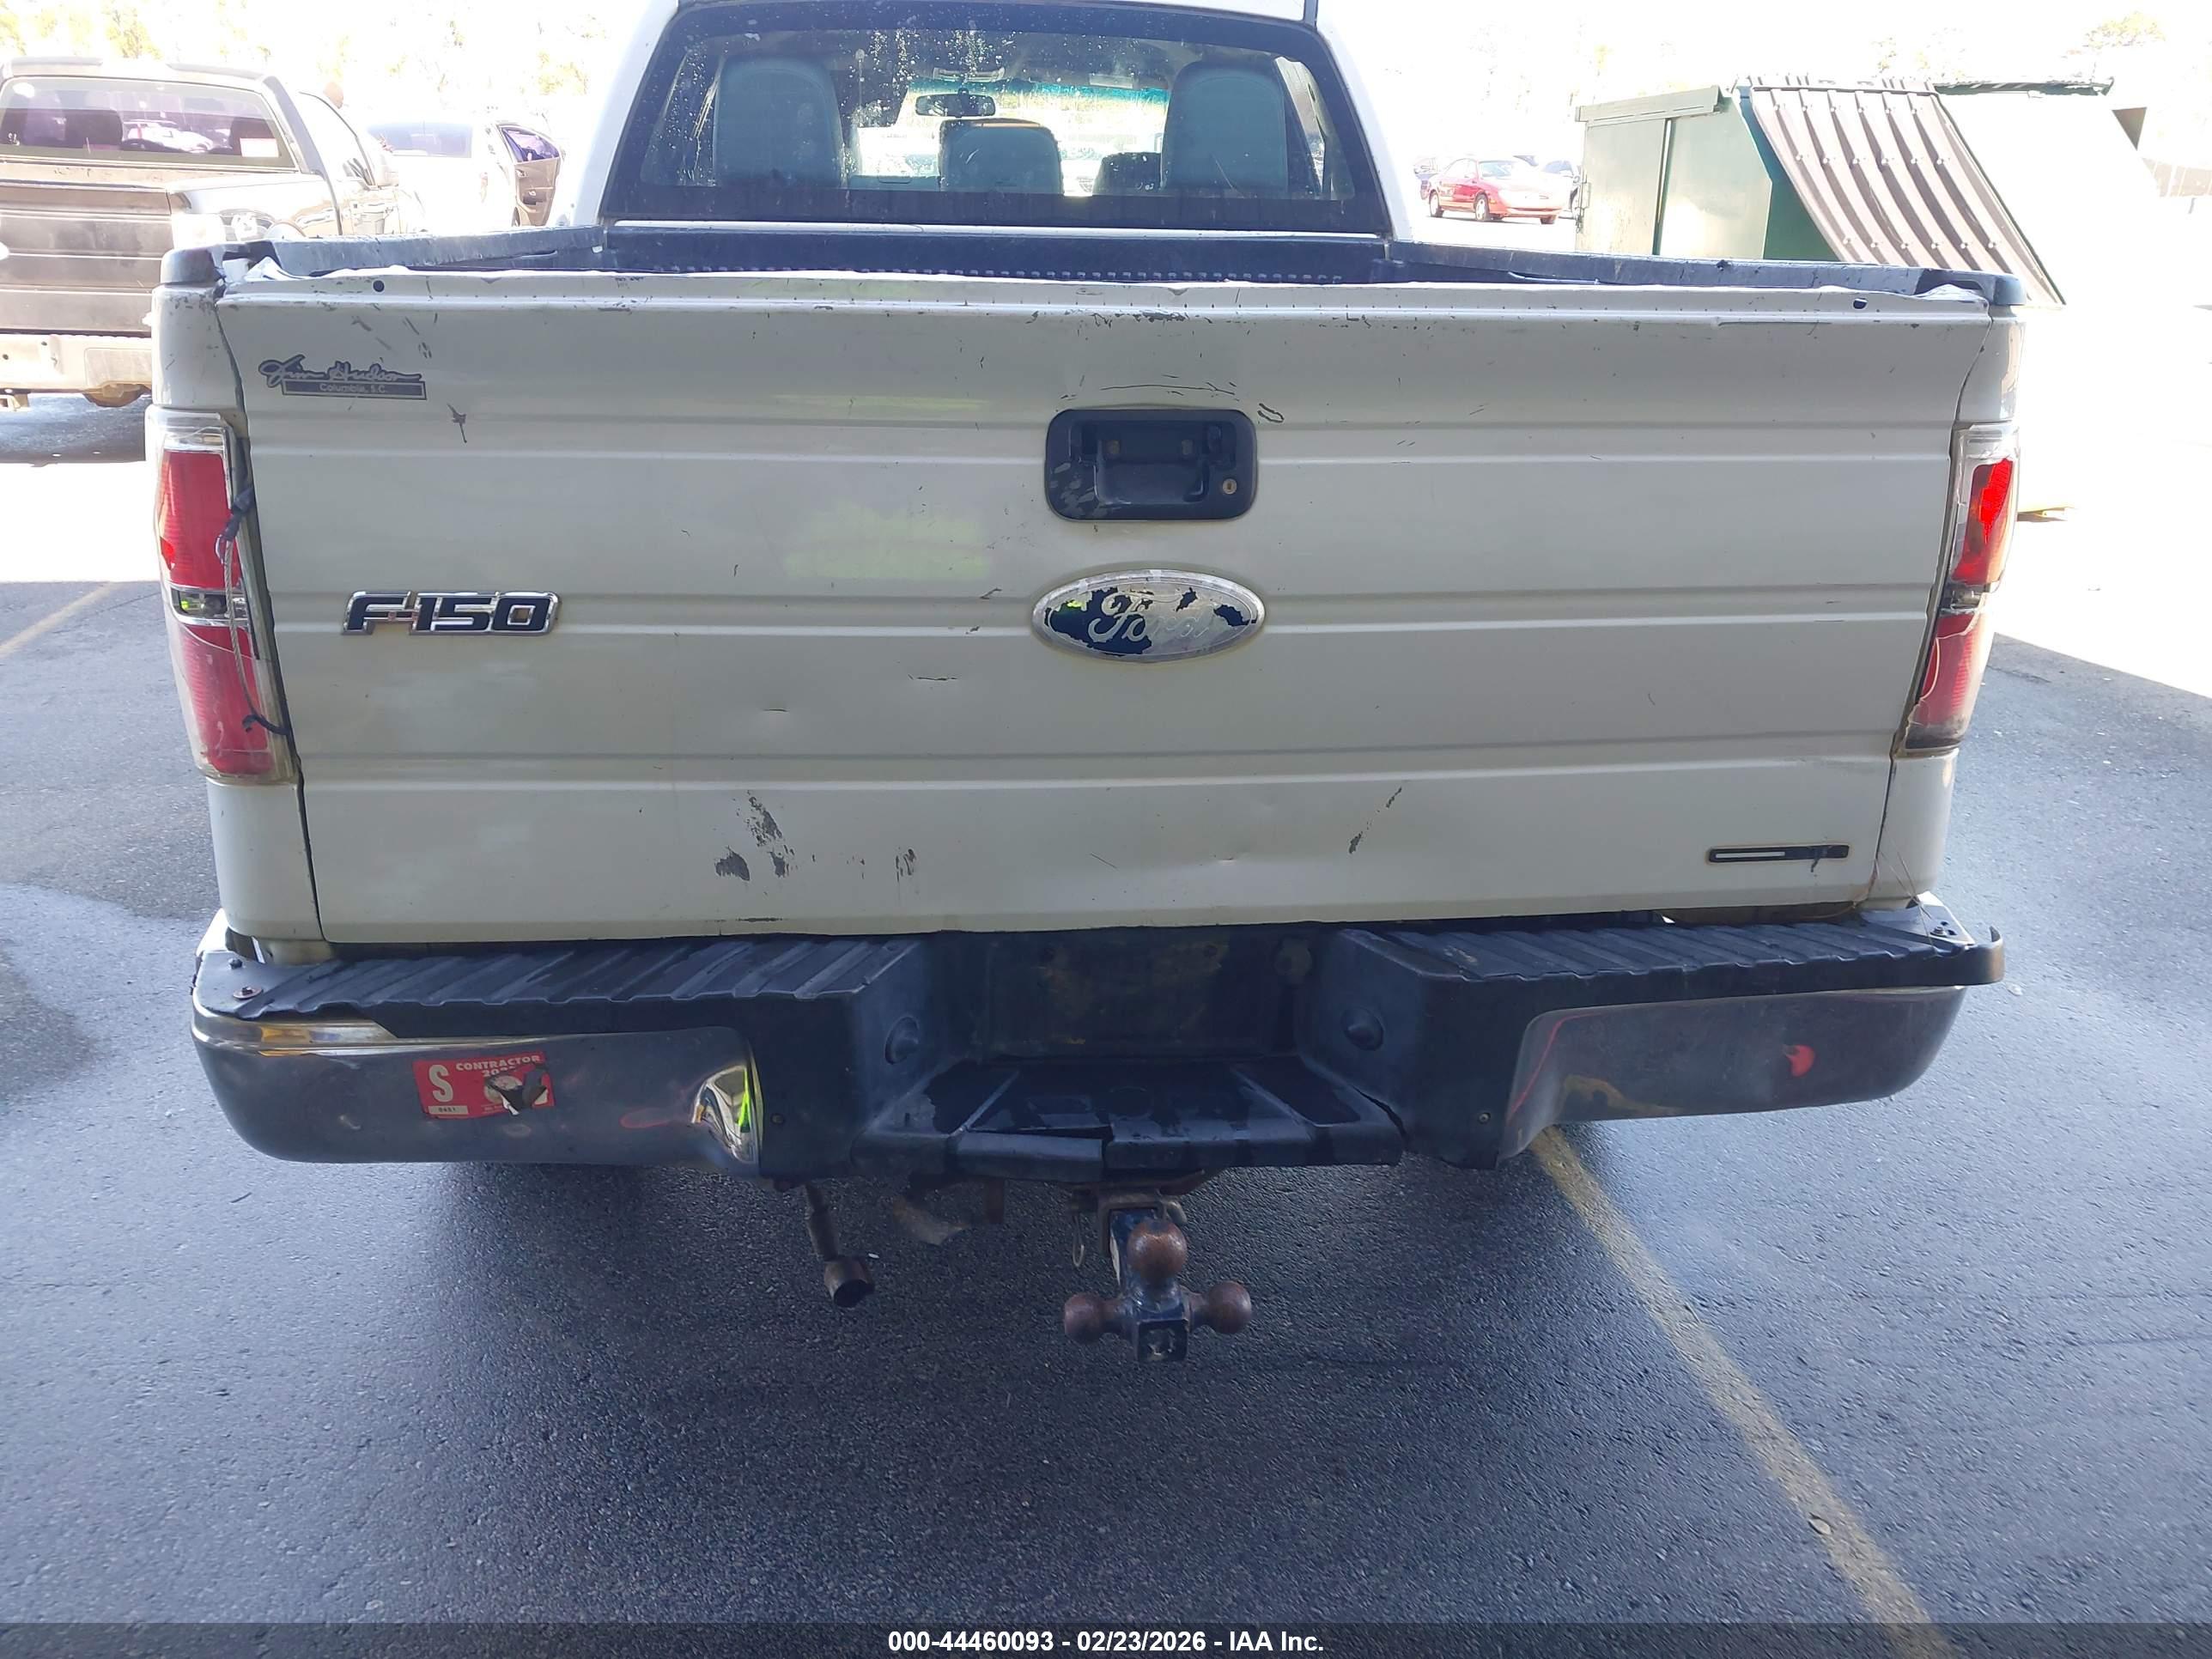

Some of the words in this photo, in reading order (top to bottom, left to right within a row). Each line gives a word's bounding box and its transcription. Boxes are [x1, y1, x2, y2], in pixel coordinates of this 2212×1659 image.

[342, 591, 559, 635] F-150
[455, 1054, 541, 1071] CONTRACTOR
[428, 1064, 453, 1103] S
